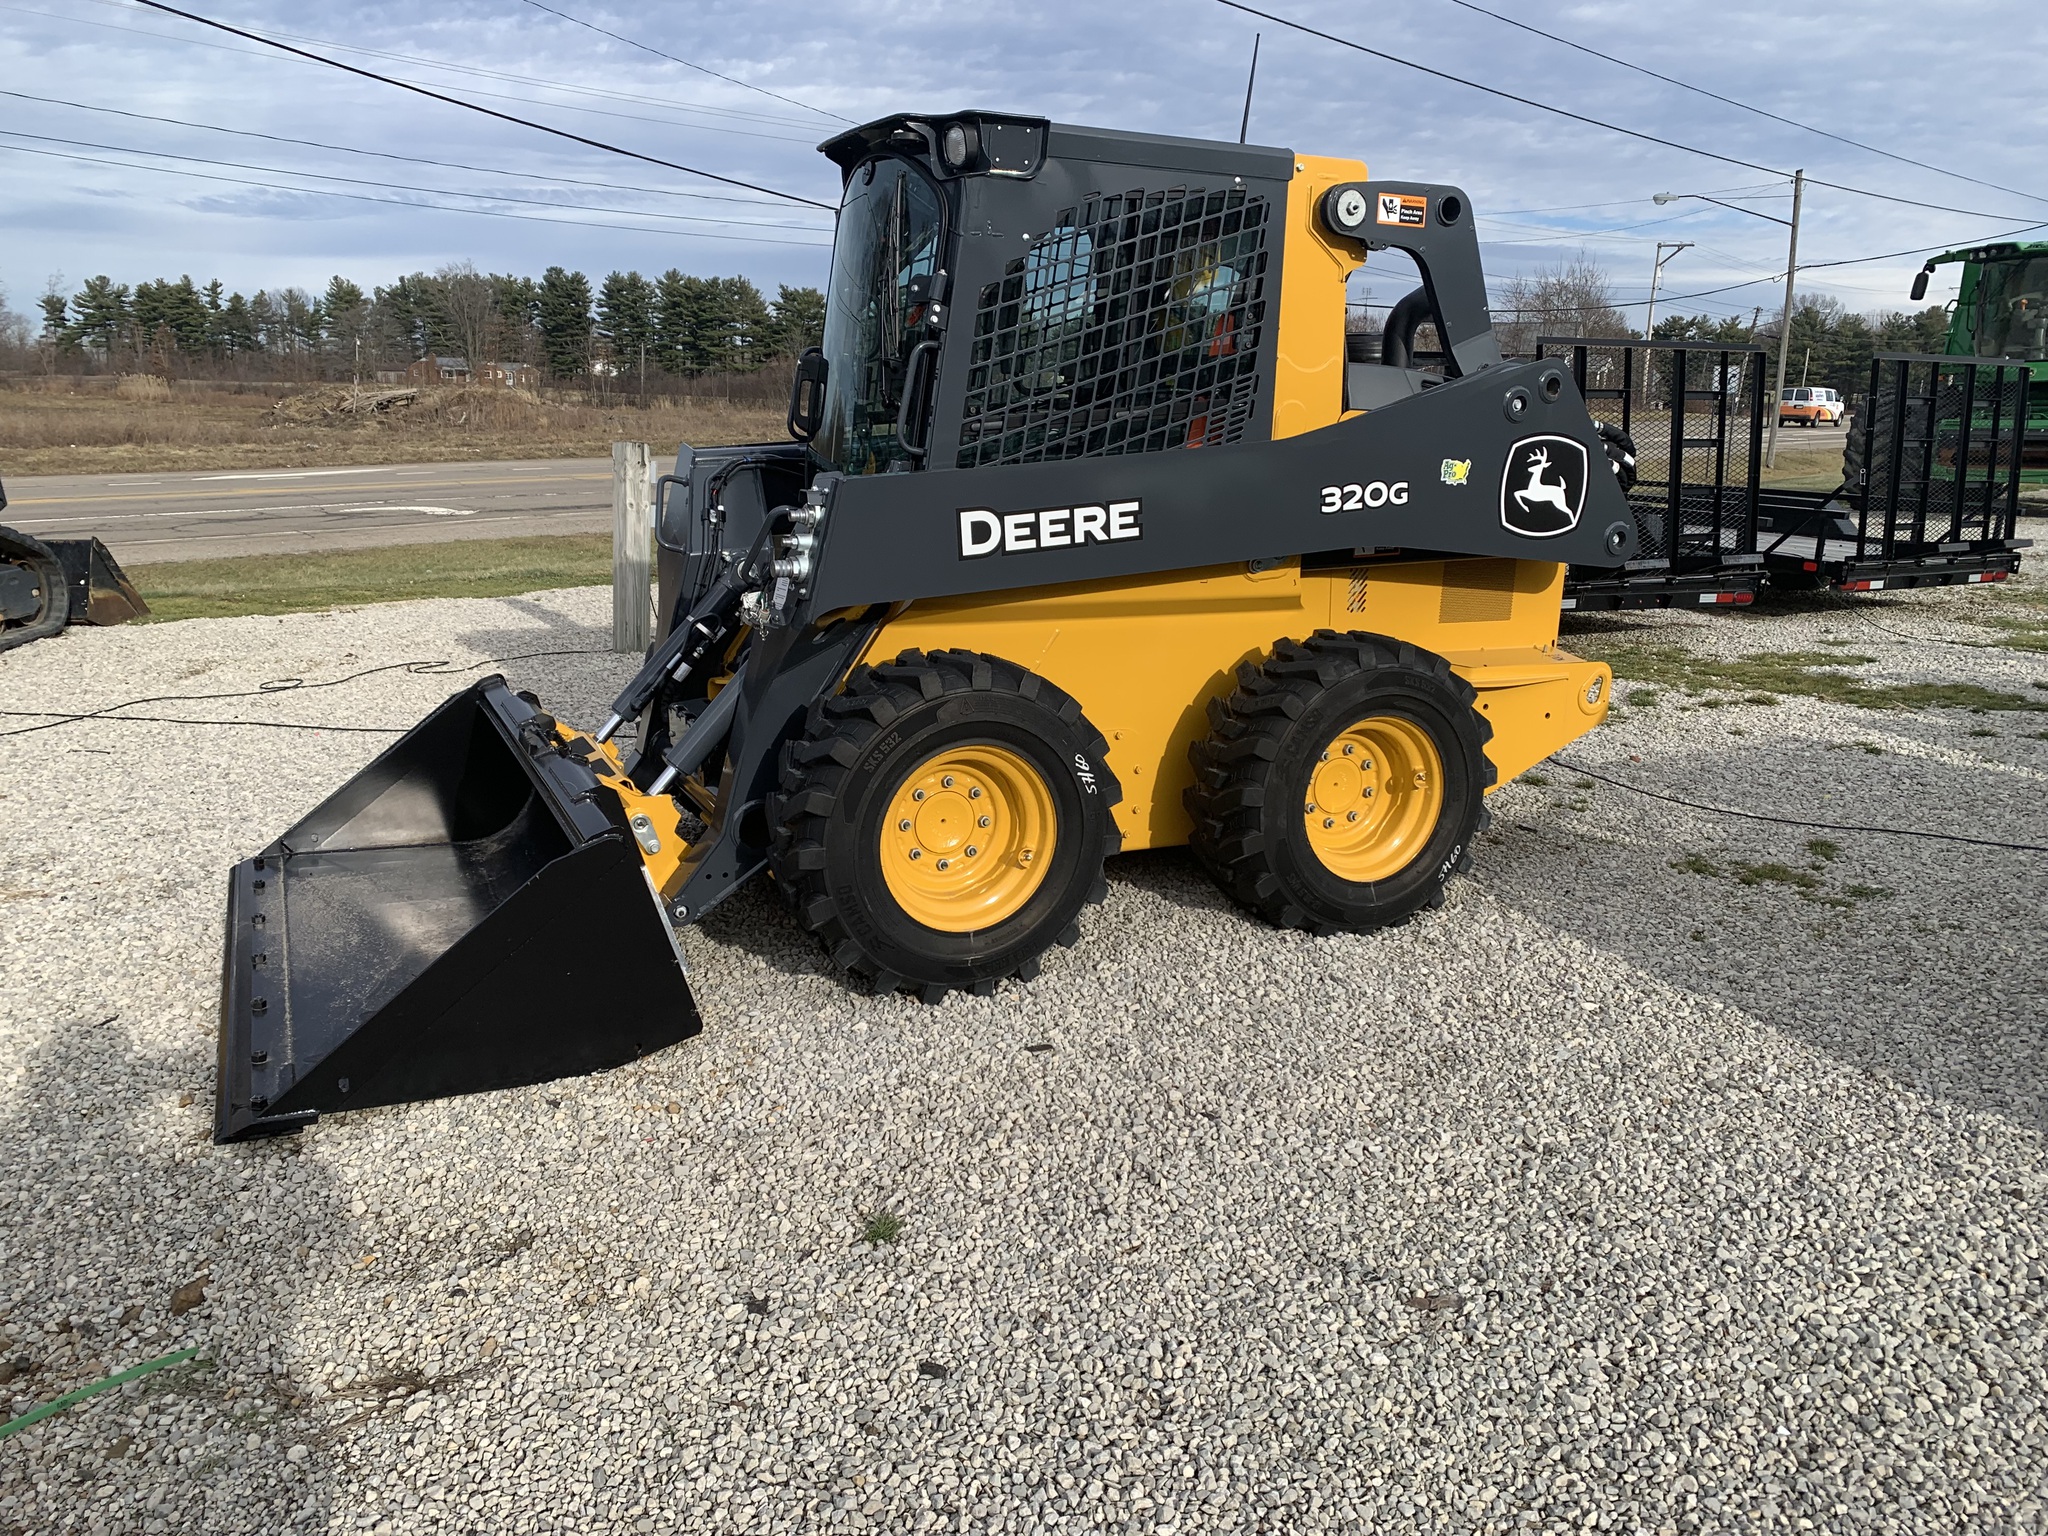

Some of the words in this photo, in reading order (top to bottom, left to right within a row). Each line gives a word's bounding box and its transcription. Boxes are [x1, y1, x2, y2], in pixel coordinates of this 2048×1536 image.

[1443, 470, 1457, 478] Pro
[1321, 481, 1409, 513] 320G
[959, 501, 1140, 556] DEERE
[863, 749, 884, 773] SKS
[883, 731, 902, 754] 532
